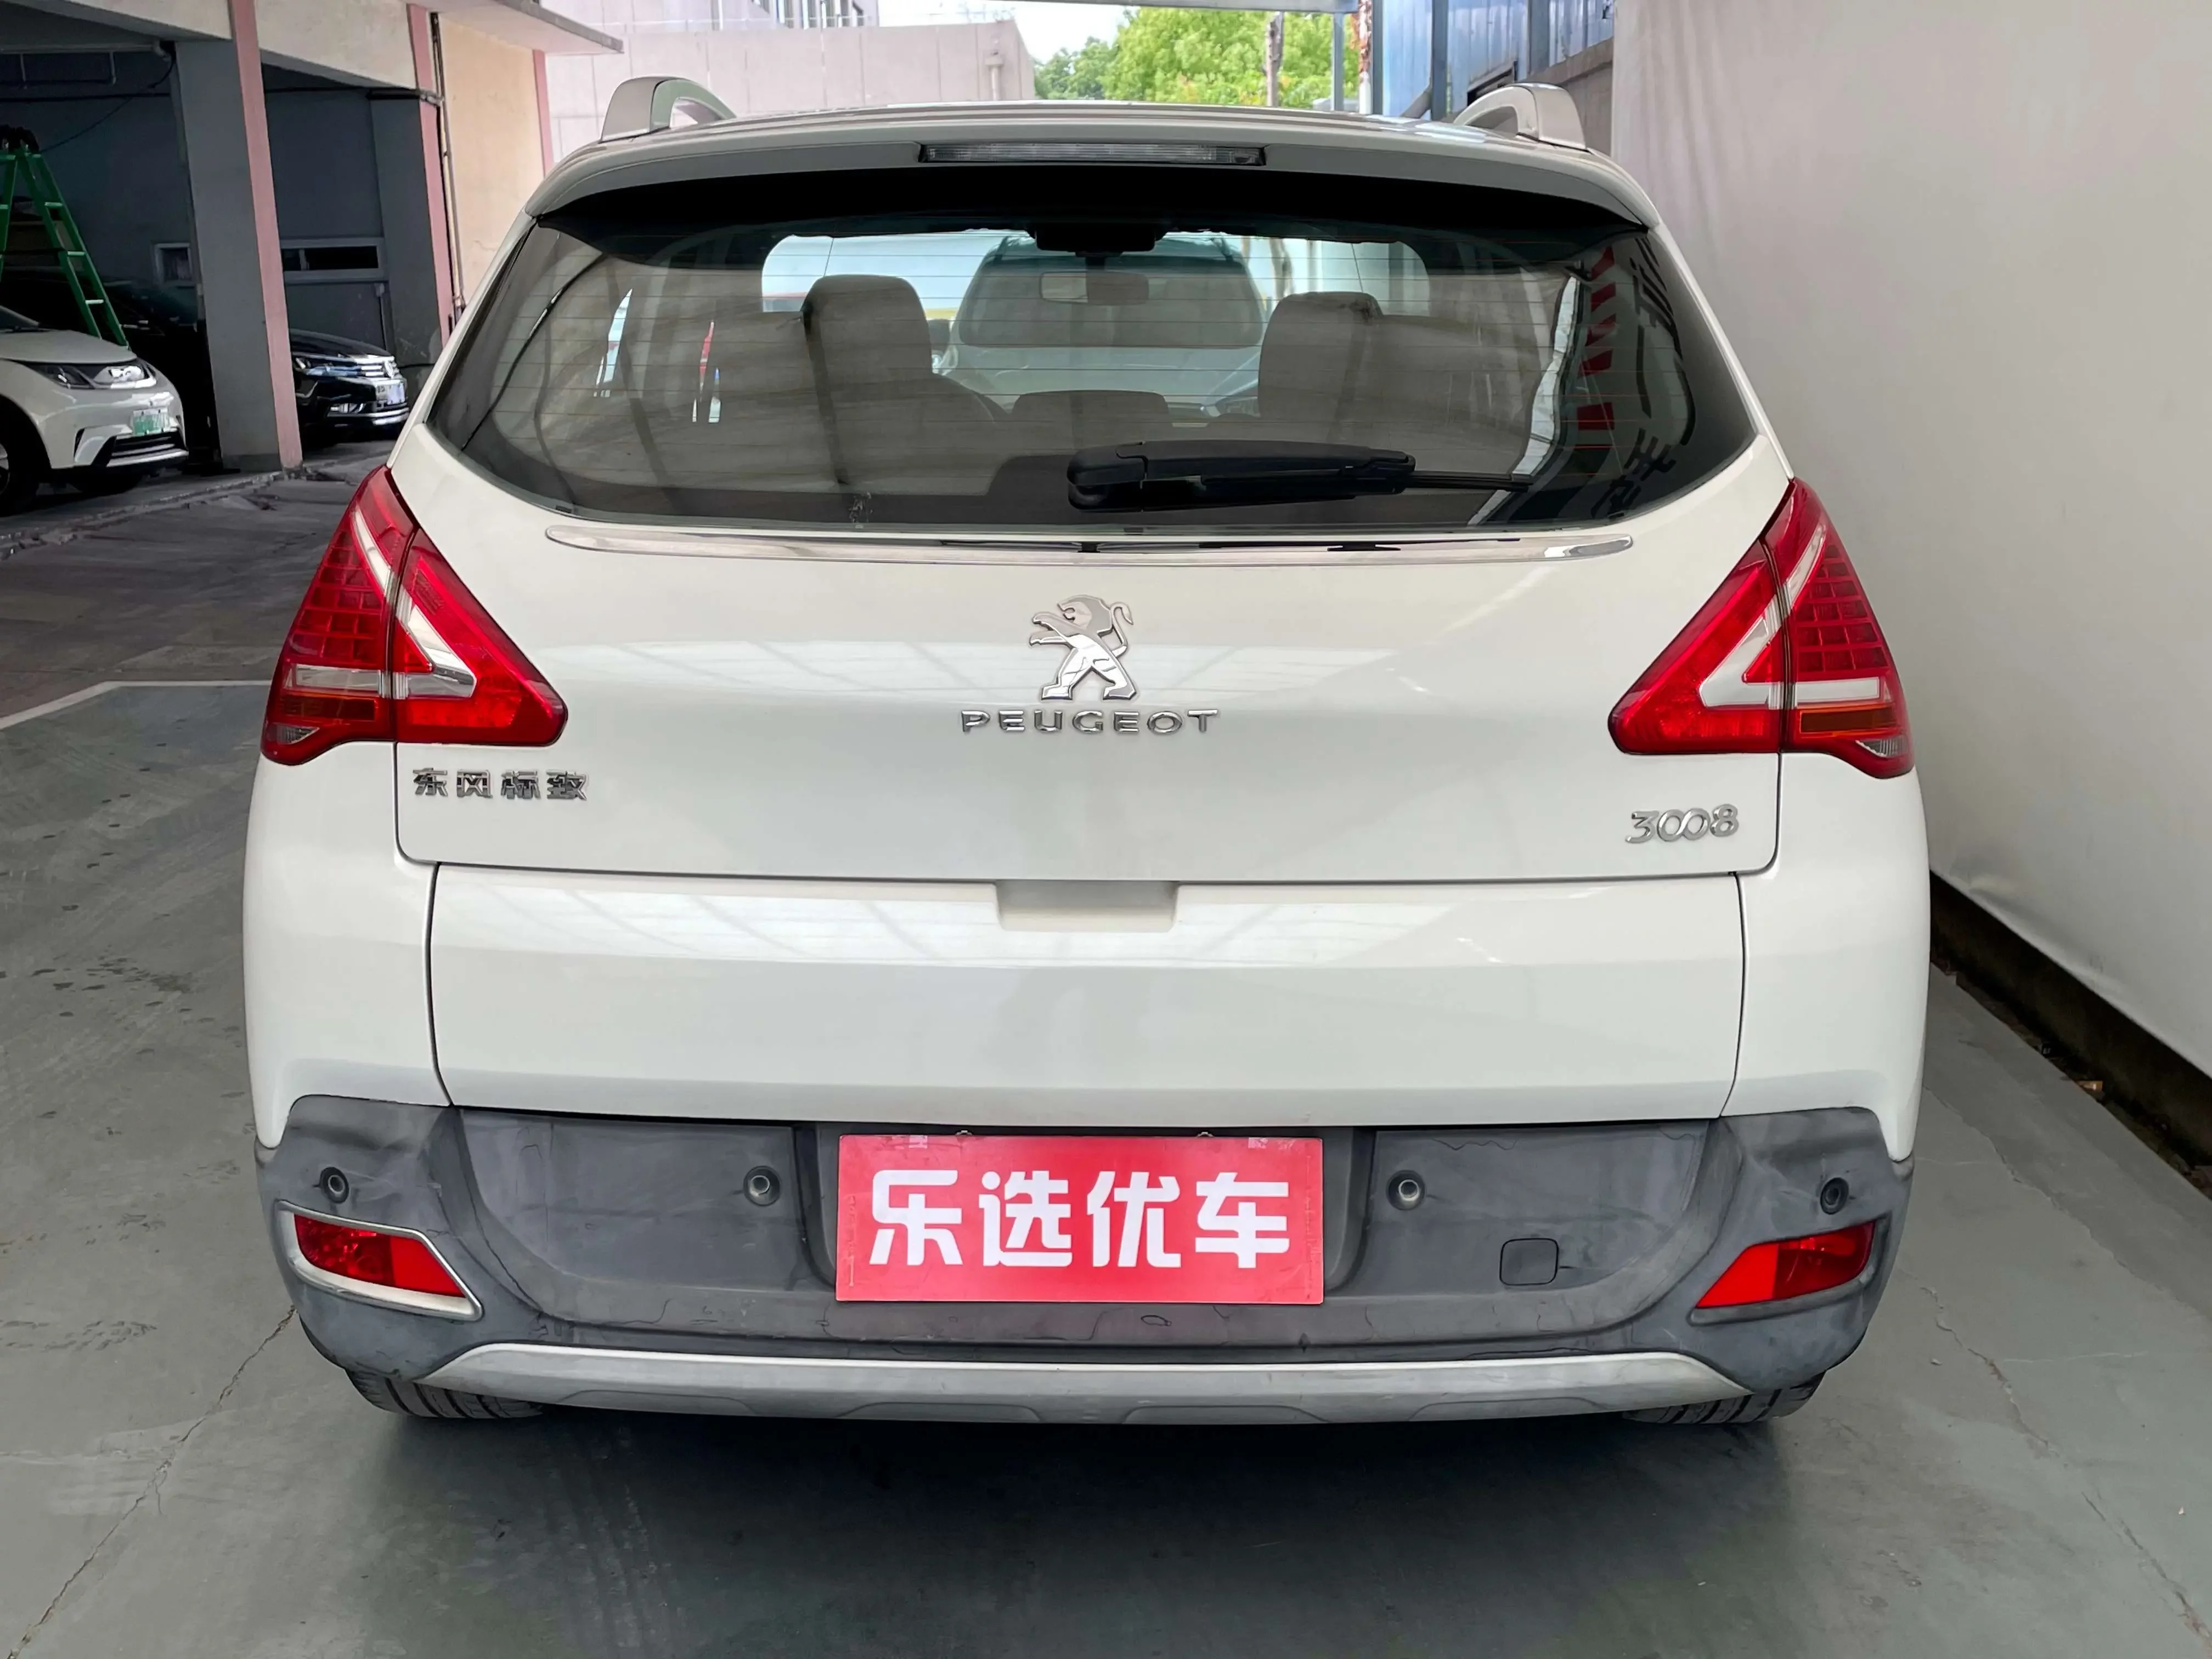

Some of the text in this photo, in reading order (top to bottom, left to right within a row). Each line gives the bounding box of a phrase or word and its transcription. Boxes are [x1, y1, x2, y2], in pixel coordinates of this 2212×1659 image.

[961, 710, 1218, 733] PEUGEOT
[413, 768, 588, 800] 东风标致
[1626, 803, 1739, 843] 3008
[870, 1169, 1290, 1268] 乐选优车
